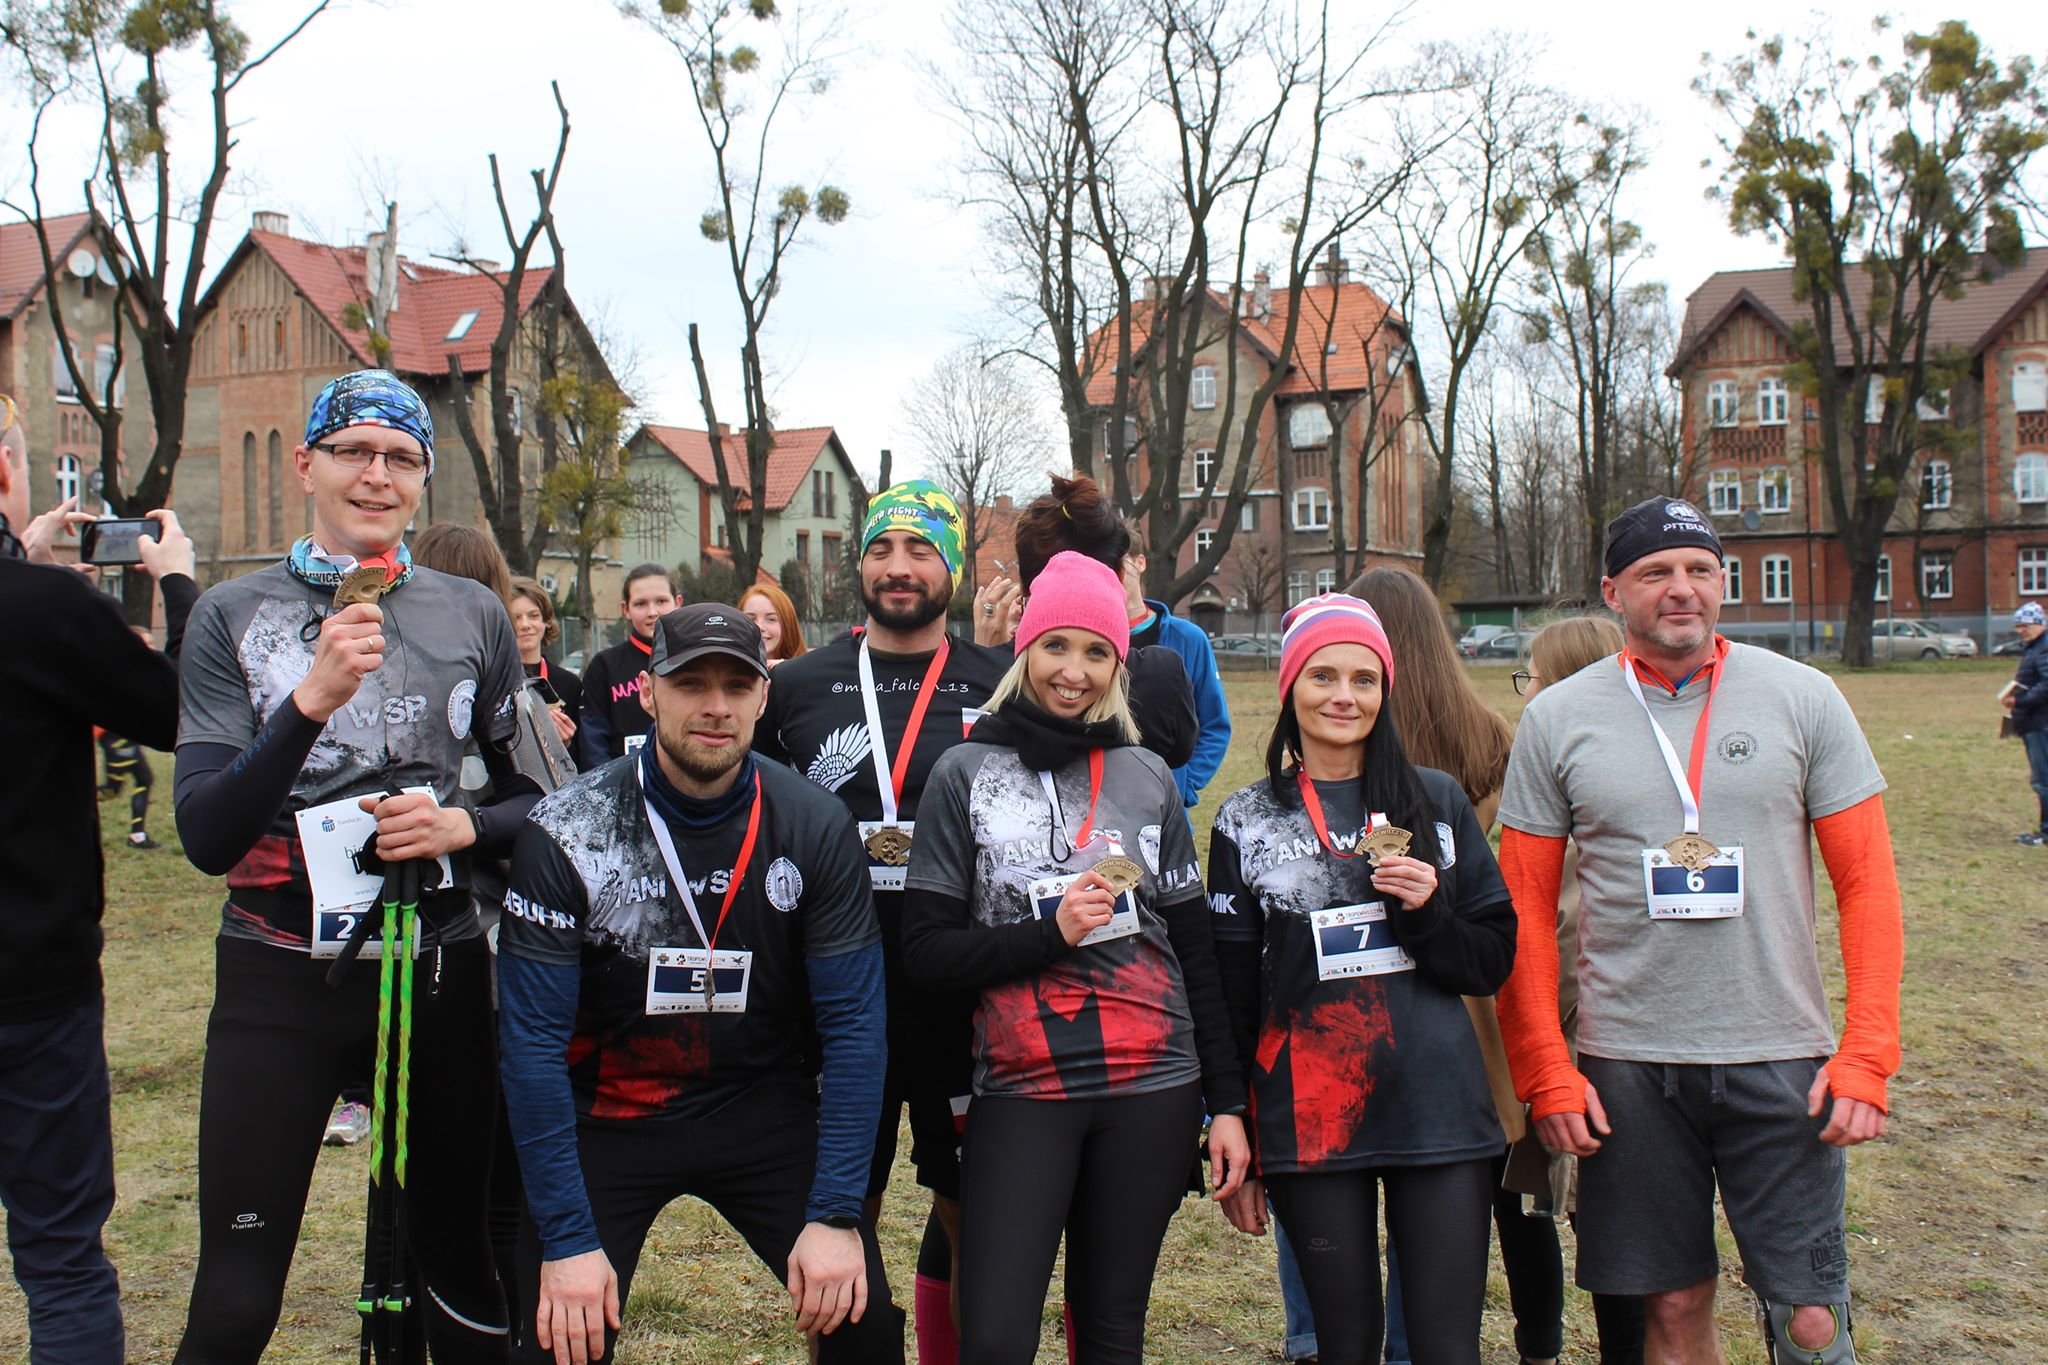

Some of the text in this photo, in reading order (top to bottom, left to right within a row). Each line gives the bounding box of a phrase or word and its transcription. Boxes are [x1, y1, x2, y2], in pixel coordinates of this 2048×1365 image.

[887, 506, 919, 517] FIGHT
[346, 694, 427, 729] WSP
[232, 727, 276, 776] KIPSTA
[1686, 869, 1705, 893] 6
[1352, 923, 1371, 950] 7
[690, 969, 708, 993] 5
